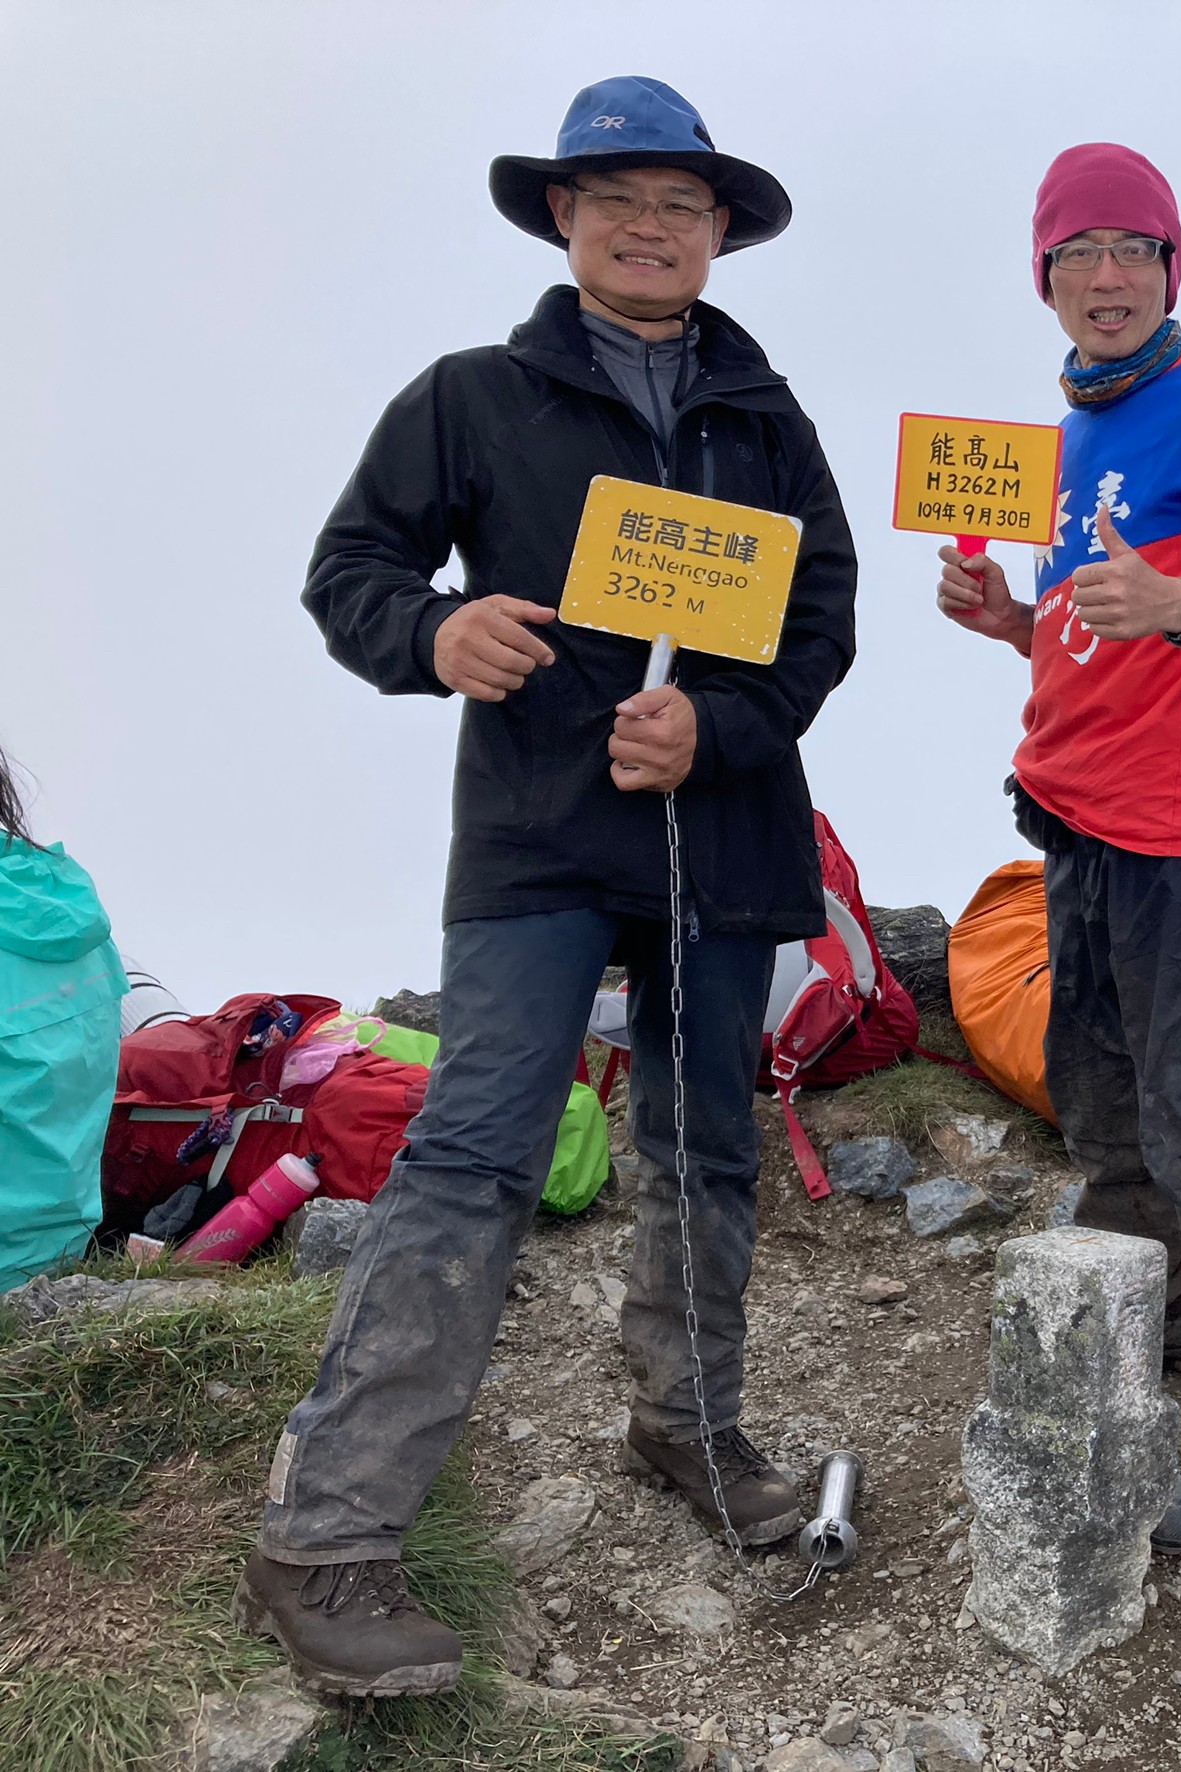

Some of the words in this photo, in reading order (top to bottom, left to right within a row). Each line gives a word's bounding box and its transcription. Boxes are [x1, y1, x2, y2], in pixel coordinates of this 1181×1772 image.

[590, 115, 626, 130] OR
[617, 508, 760, 565] 能高主峰
[603, 571, 677, 608] 3262
[686, 597, 705, 615] M
